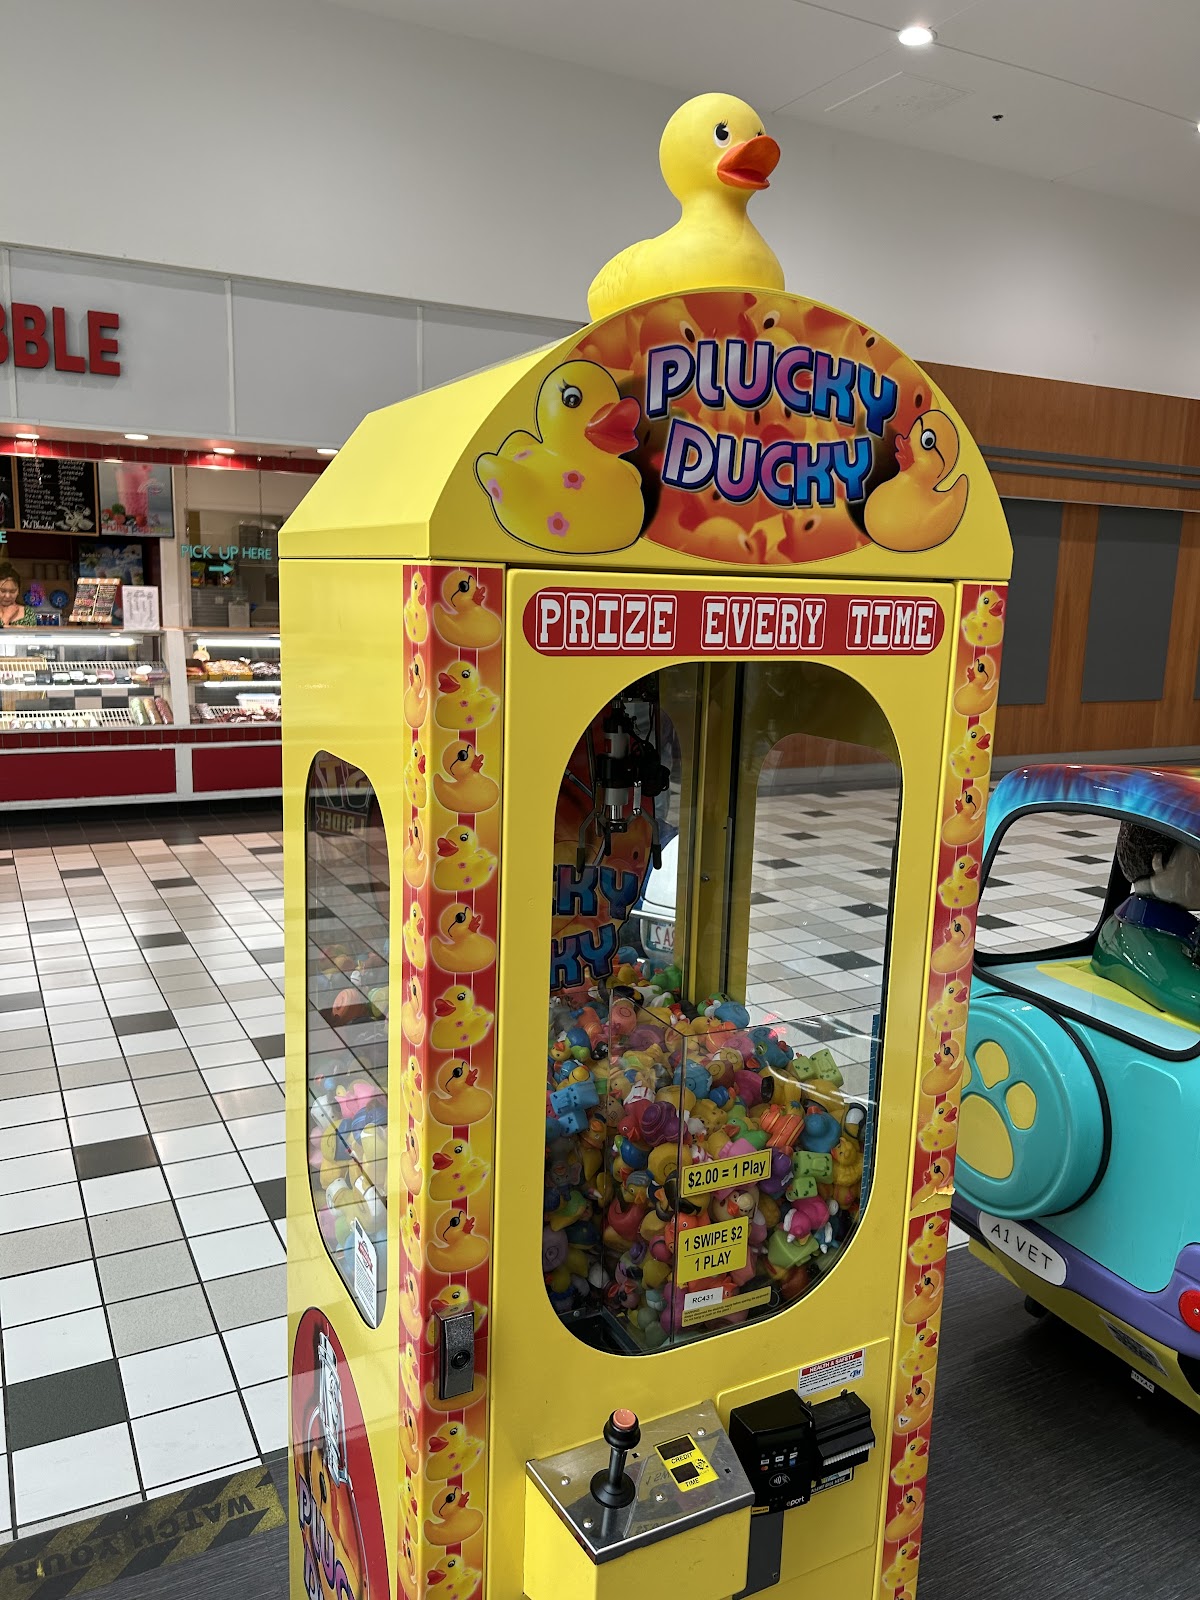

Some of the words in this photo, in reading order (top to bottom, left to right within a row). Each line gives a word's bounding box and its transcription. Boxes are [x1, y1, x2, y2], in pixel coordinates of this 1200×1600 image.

[0, 302, 120, 376] BLE
[646, 339, 898, 438] PLUCKY
[662, 418, 873, 508] DUCKY
[181, 545, 212, 559] PICK
[219, 546, 239, 560] UP
[242, 547, 272, 560] HERE
[538, 596, 676, 646] PRIZE
[703, 601, 825, 647] EVERY
[849, 603, 934, 648] TIME
[688, 1168, 719, 1189] $2.00
[722, 1169, 729, 1177] =
[732, 1163, 738, 1178] 1
[743, 1160, 766, 1176] Play
[685, 1238, 690, 1252] 1
[693, 1229, 728, 1250] SWIPE
[730, 1226, 743, 1242] $2
[990, 1223, 1010, 1244] A1
[1016, 1235, 1053, 1270] VET
[695, 1258, 700, 1272] 1
[704, 1250, 731, 1270] PLAY
[692, 1294, 714, 1304] RC431
[809, 1363, 830, 1373] HEALTH
[835, 1354, 856, 1365] SAFETY
[671, 1452, 693, 1464] CREDIT
[685, 1477, 699, 1487] TIME
[129, 1493, 256, 1549] WATCH
[14, 1534, 128, 1585] YOUR
